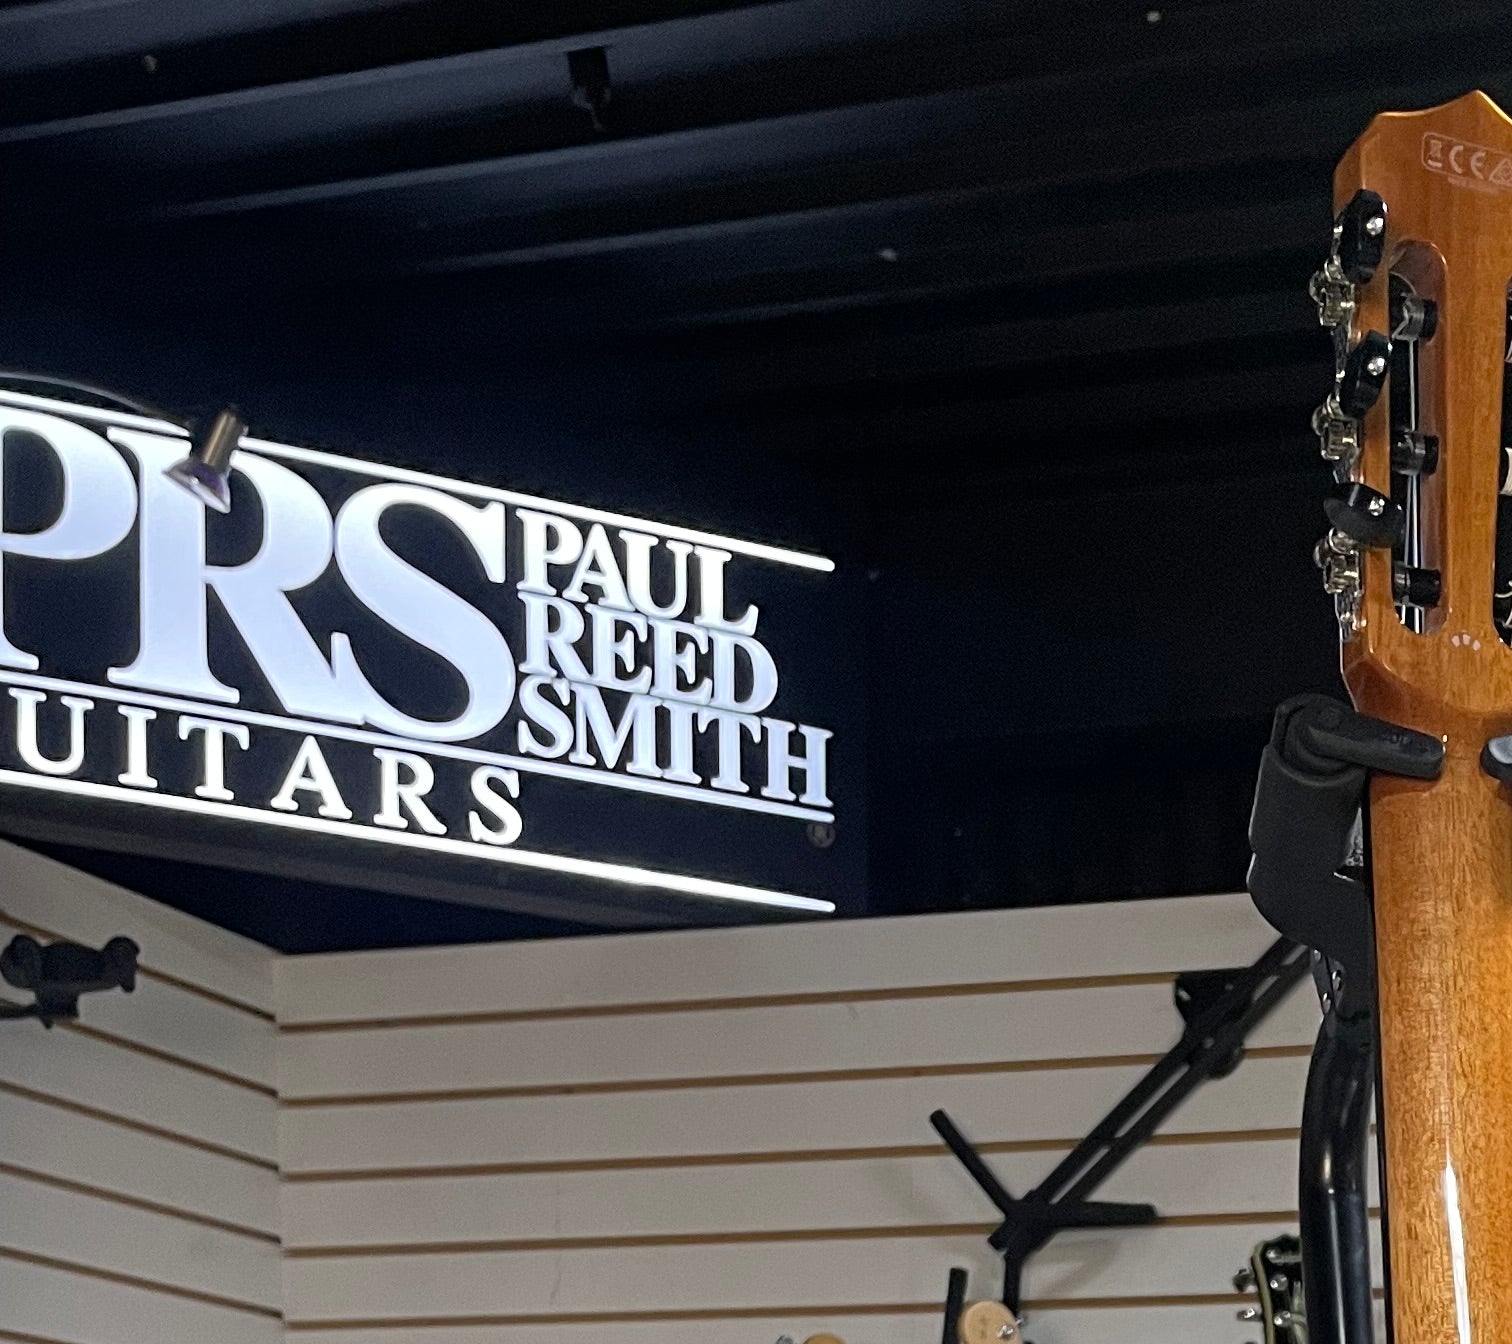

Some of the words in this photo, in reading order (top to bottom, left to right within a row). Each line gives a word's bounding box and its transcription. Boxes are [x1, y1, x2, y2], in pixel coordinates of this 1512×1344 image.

[0, 406, 516, 742] PRS
[516, 507, 759, 635] PAUL
[517, 590, 779, 714] REED
[8, 687, 523, 845] UITARS
[517, 676, 834, 808] SMITH
